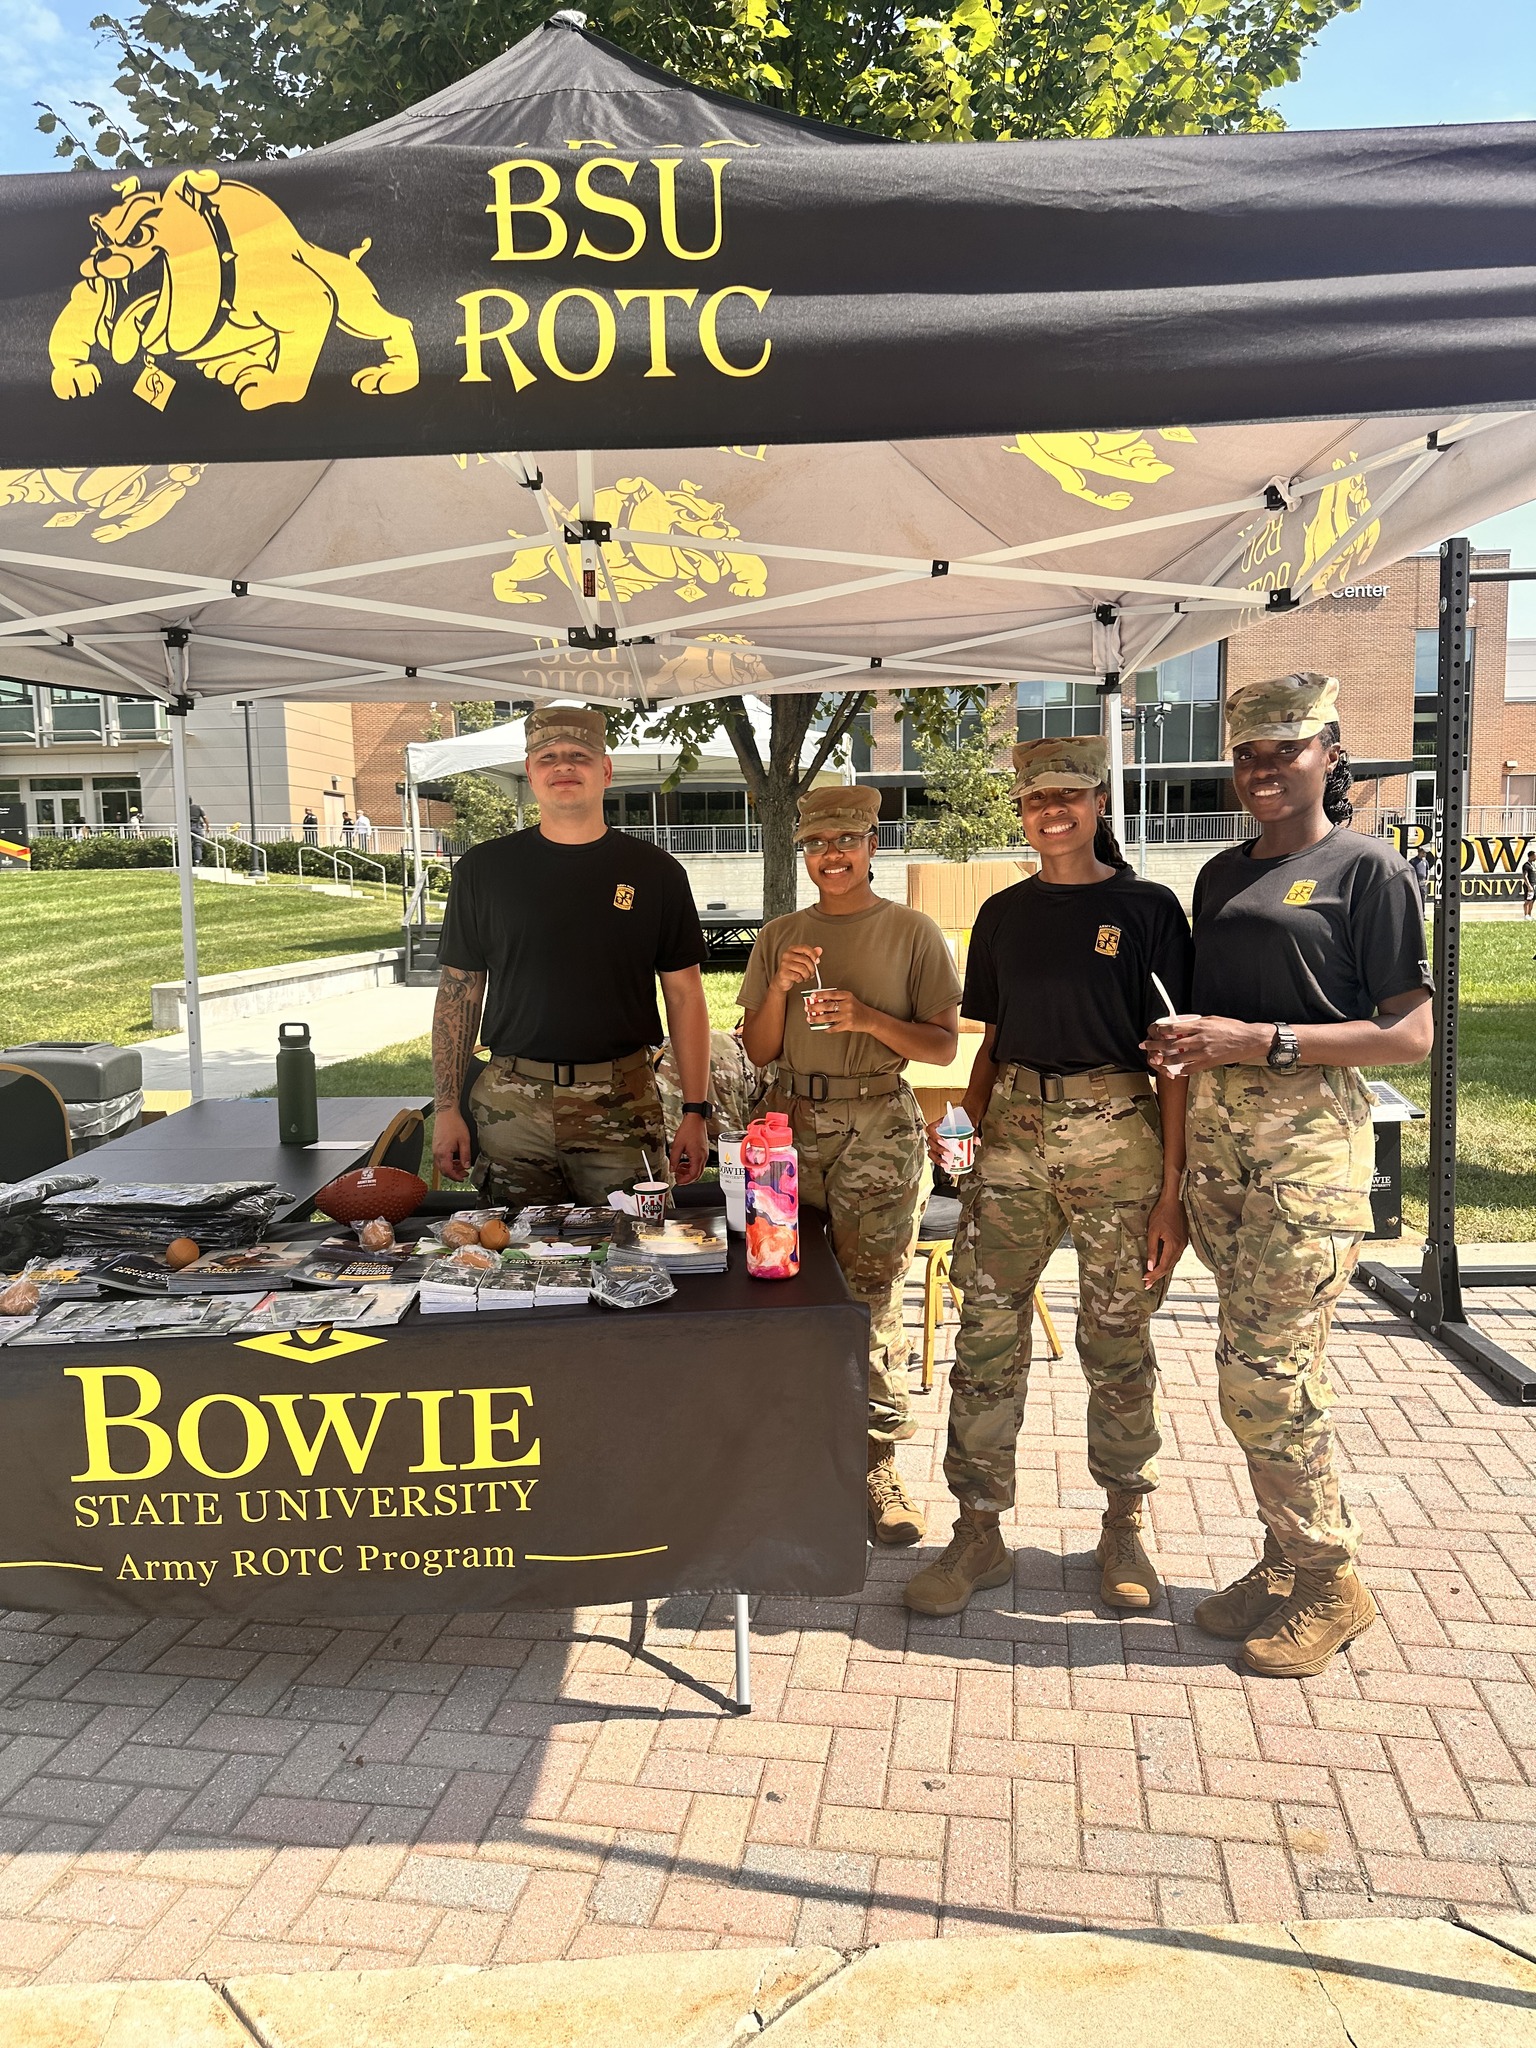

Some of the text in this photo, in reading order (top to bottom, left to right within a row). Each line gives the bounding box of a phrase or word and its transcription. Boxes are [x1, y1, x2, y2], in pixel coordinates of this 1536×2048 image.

[485, 156, 731, 262] BSU
[455, 285, 773, 392] ROTC
[1434, 797, 1445, 900] ROGUE
[644, 1203, 661, 1212] Rita's
[63, 1365, 541, 1482] BOWIE
[74, 1479, 539, 1528] STATE UNIVERSITY
[116, 1544, 516, 1587] Army ROTC Program
